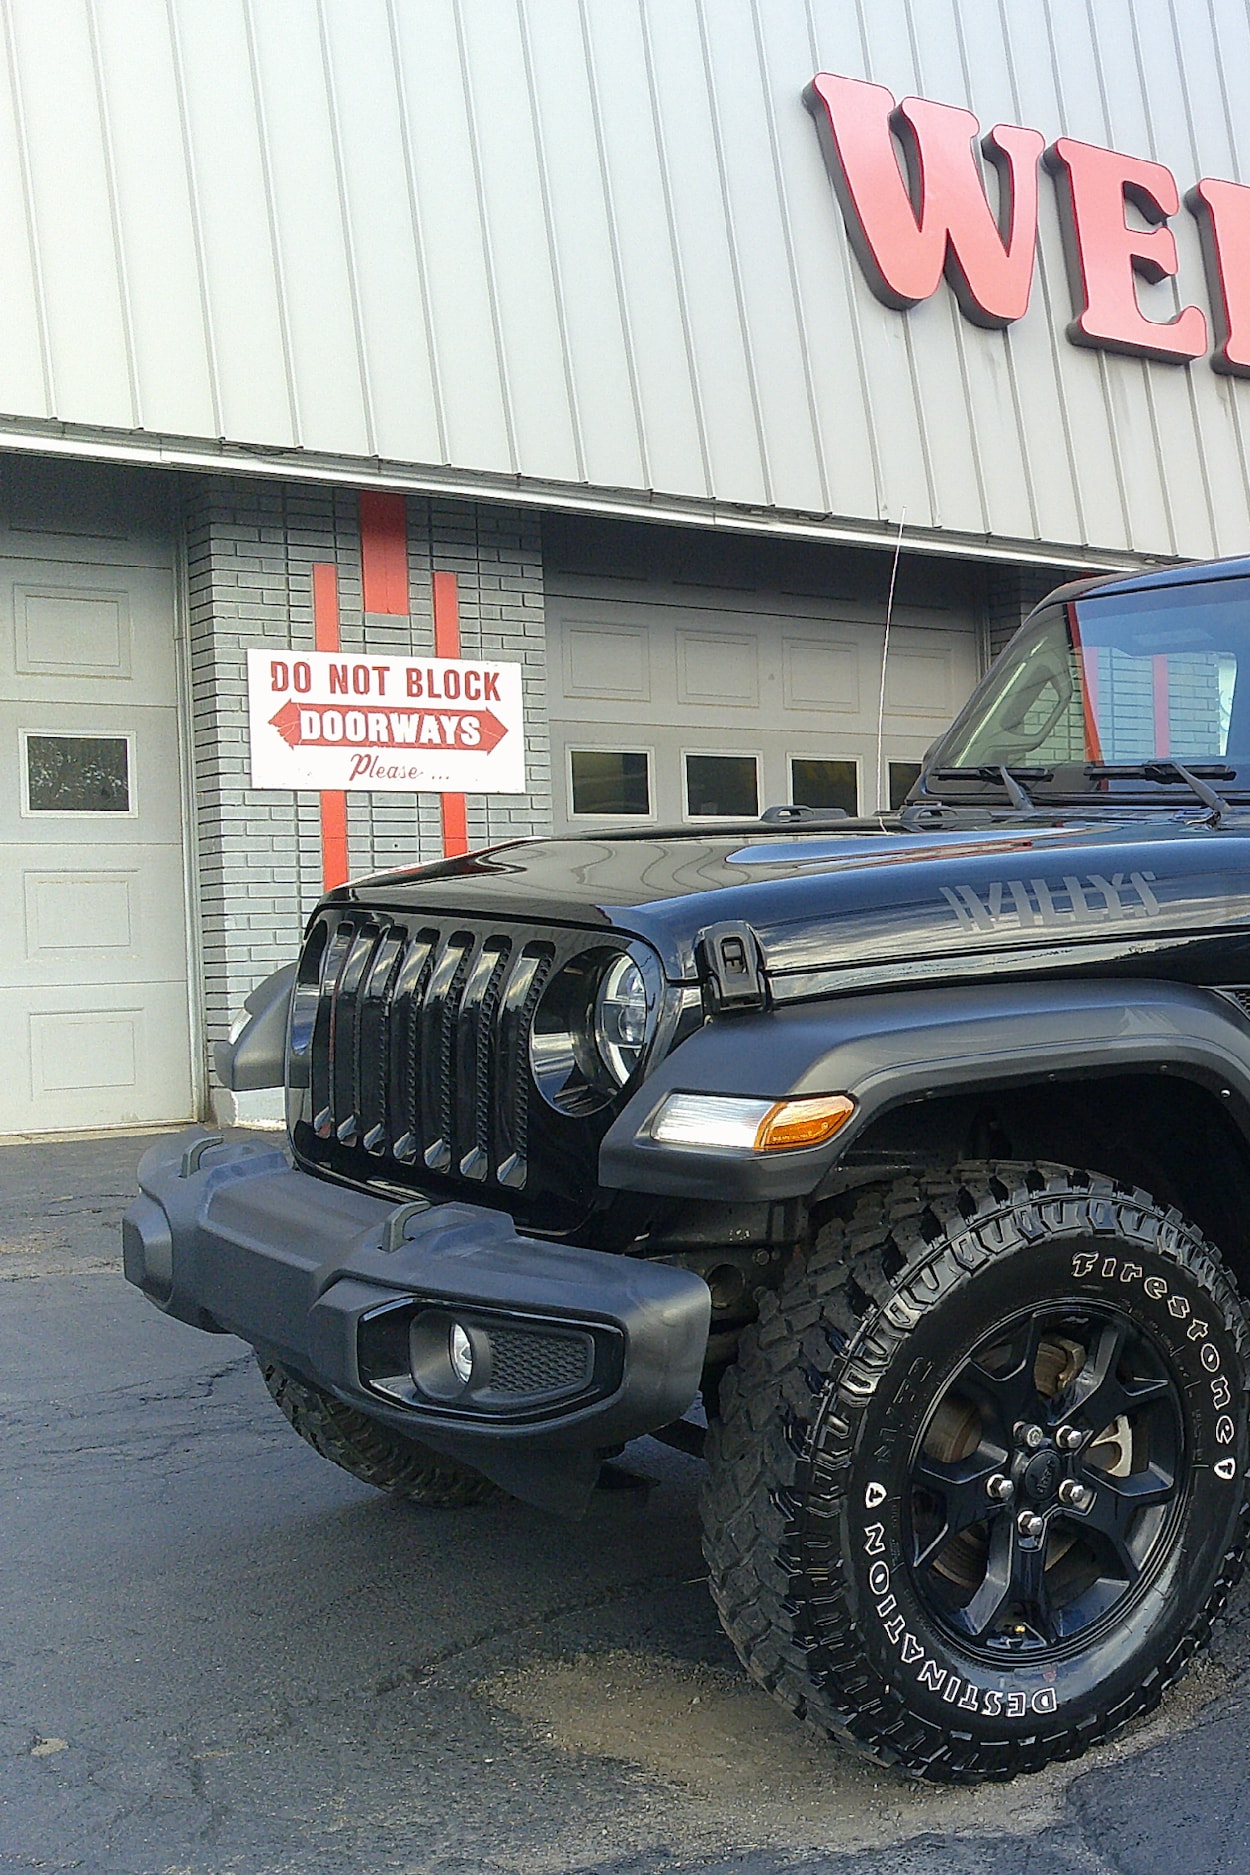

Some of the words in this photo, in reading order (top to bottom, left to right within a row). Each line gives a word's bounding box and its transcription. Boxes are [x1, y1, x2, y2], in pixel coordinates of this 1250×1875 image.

[271, 661, 312, 693] DO
[329, 664, 390, 696] NOT
[406, 668, 501, 701] BLOCK
[301, 709, 481, 746] DOORWAYS
[349, 753, 423, 781] Please
[939, 871, 1161, 931] WILLYS
[1071, 1251, 1235, 1445] Firestone
[863, 1522, 1058, 1718] DESTINATION
